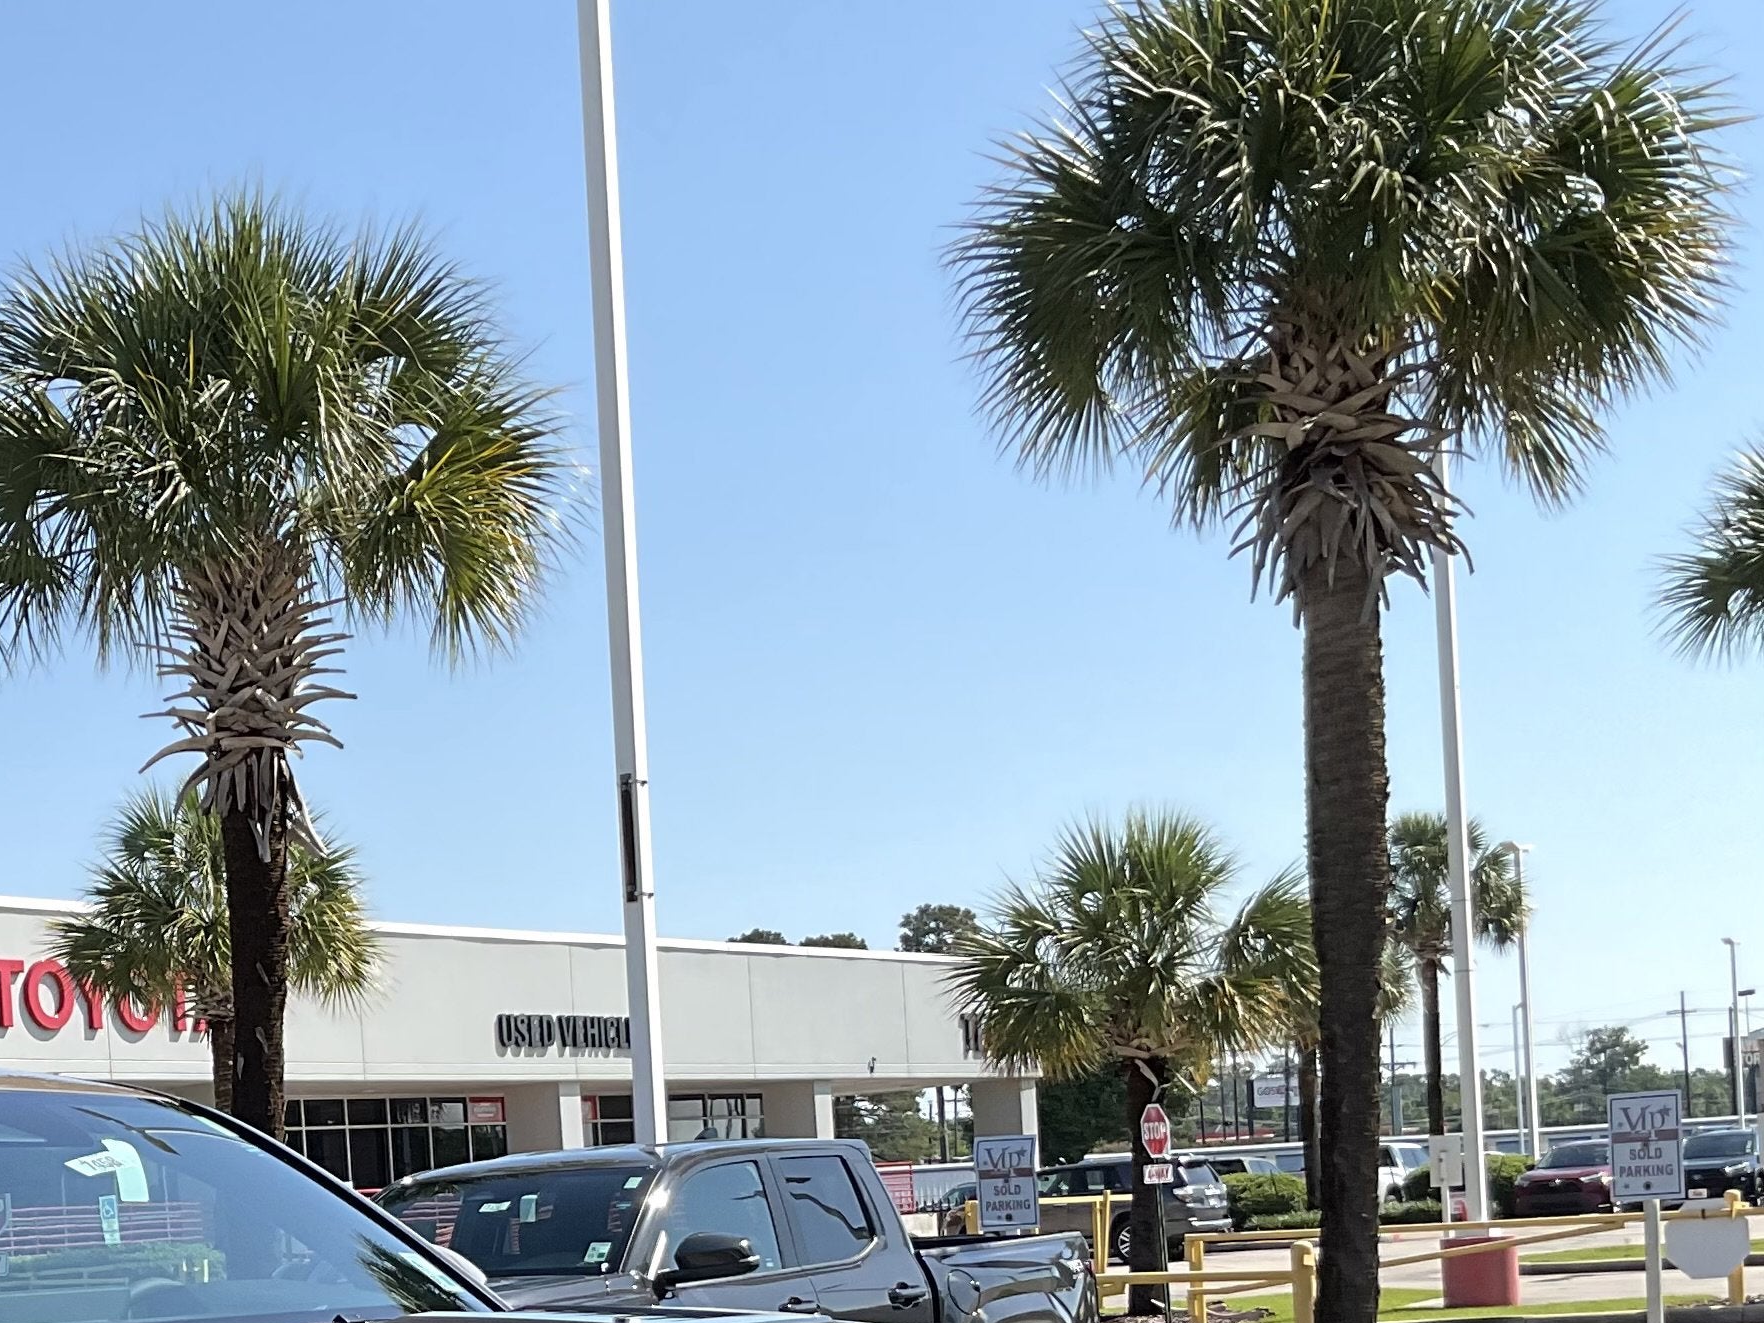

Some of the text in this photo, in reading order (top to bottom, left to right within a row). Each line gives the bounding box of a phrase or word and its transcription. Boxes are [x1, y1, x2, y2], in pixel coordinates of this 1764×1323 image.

[497, 1014, 631, 1050] USED VEHICL
[1143, 1121, 1167, 1141] STOP
[1629, 1147, 1663, 1161] SOLD
[1619, 1164, 1674, 1178] PARKING
[993, 1184, 1022, 1197] SOLD
[985, 1199, 1031, 1212] PARKING
